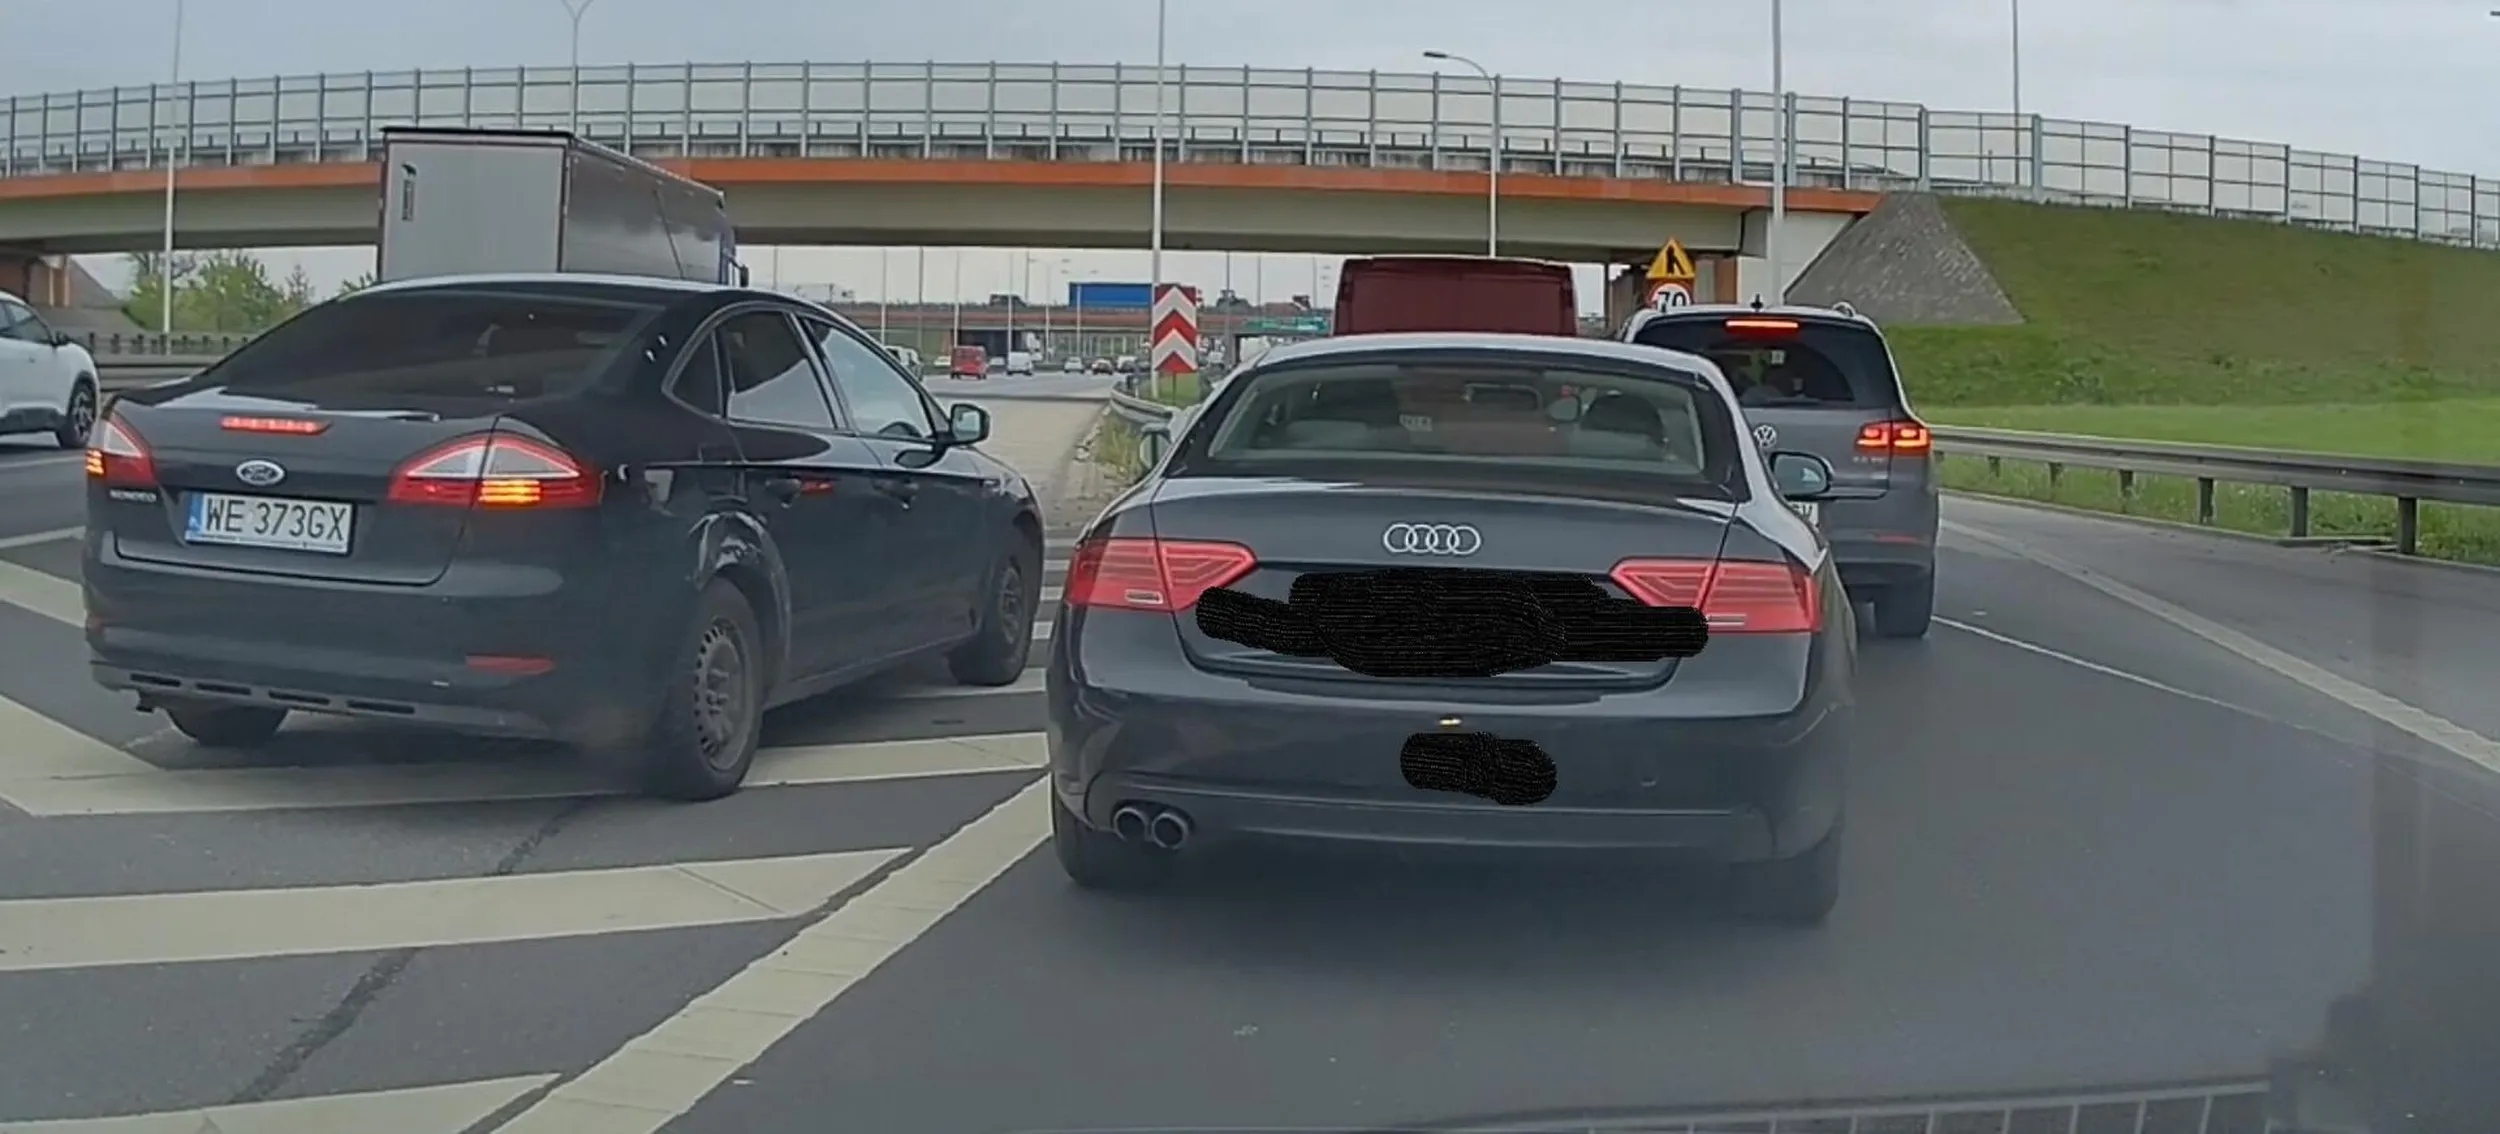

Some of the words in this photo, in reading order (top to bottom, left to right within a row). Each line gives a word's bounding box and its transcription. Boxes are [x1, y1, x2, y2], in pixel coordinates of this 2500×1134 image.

[1658, 291, 1687, 313] 70
[206, 498, 246, 533] WE
[254, 502, 347, 542] 373GX
